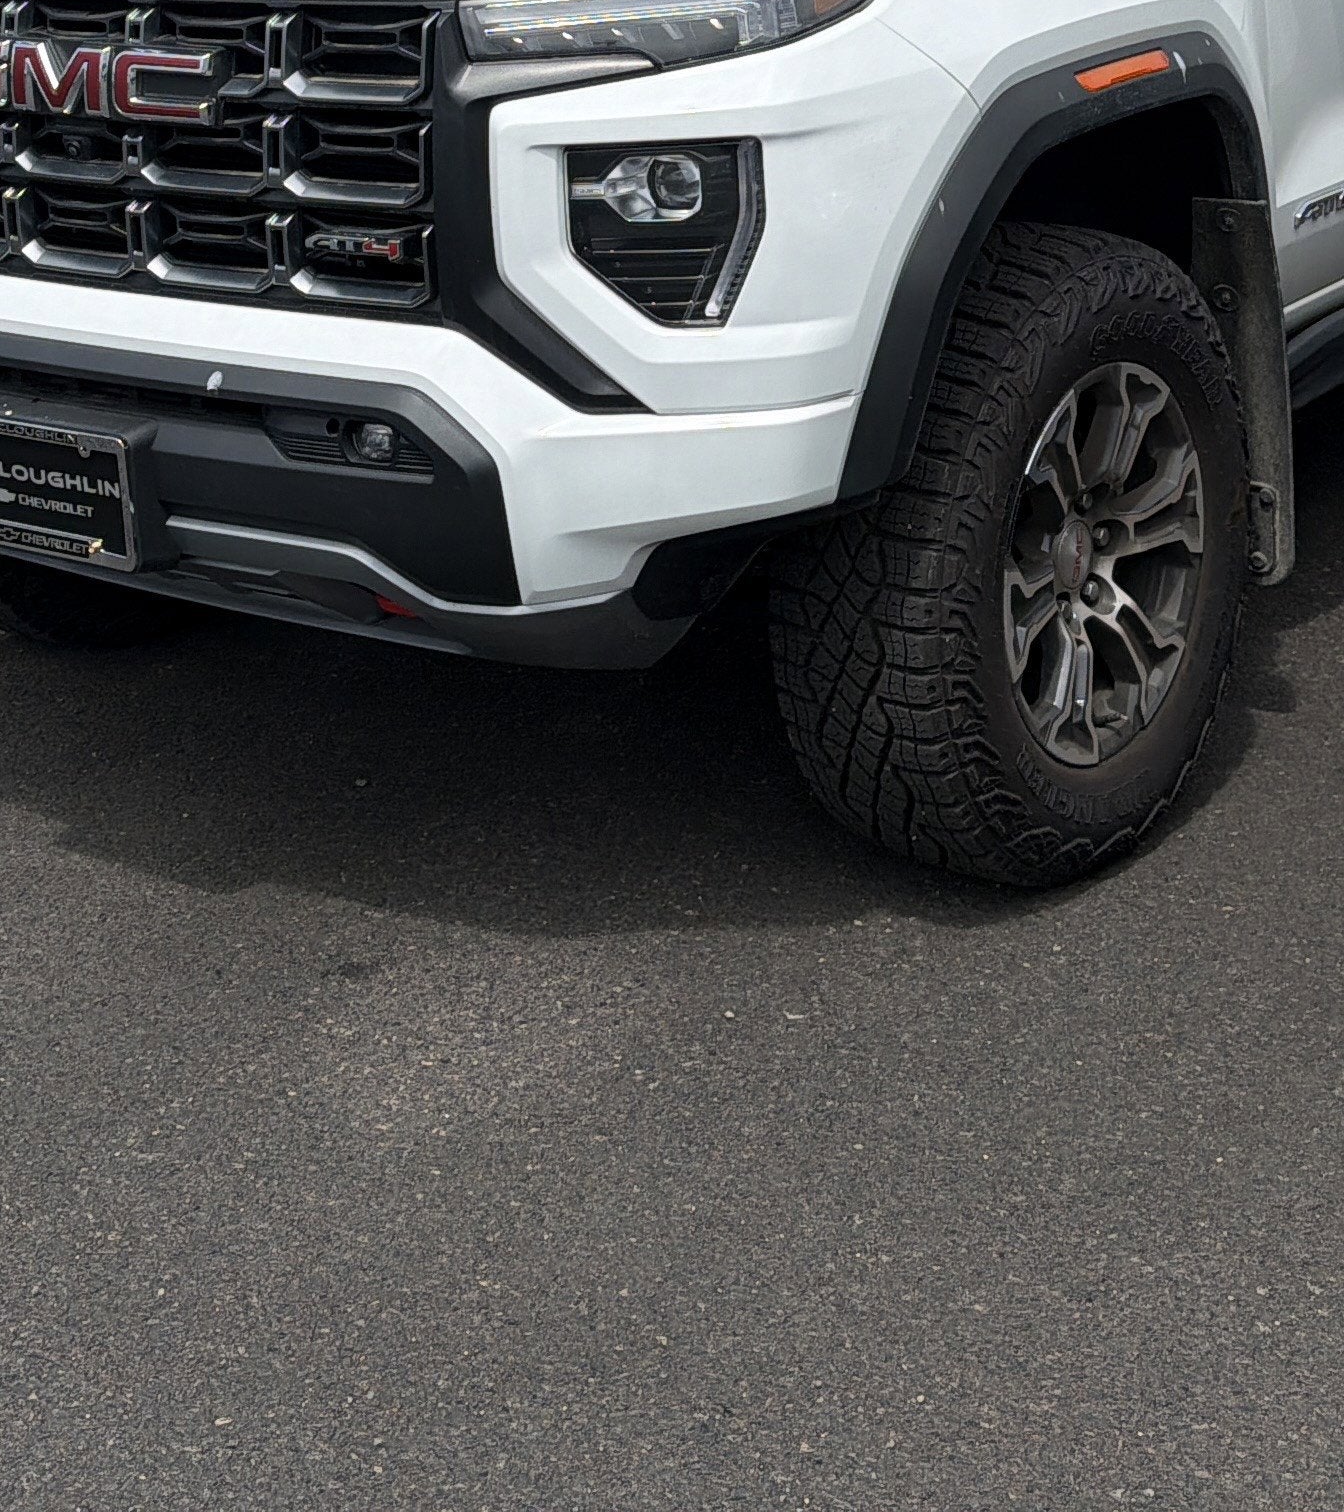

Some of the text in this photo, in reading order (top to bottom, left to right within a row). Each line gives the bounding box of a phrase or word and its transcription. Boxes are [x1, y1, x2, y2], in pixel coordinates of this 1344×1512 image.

[304, 233, 402, 261] AT4
[17, 493, 95, 518] CHEVROLET
[21, 532, 90, 555] CHEVROLET
